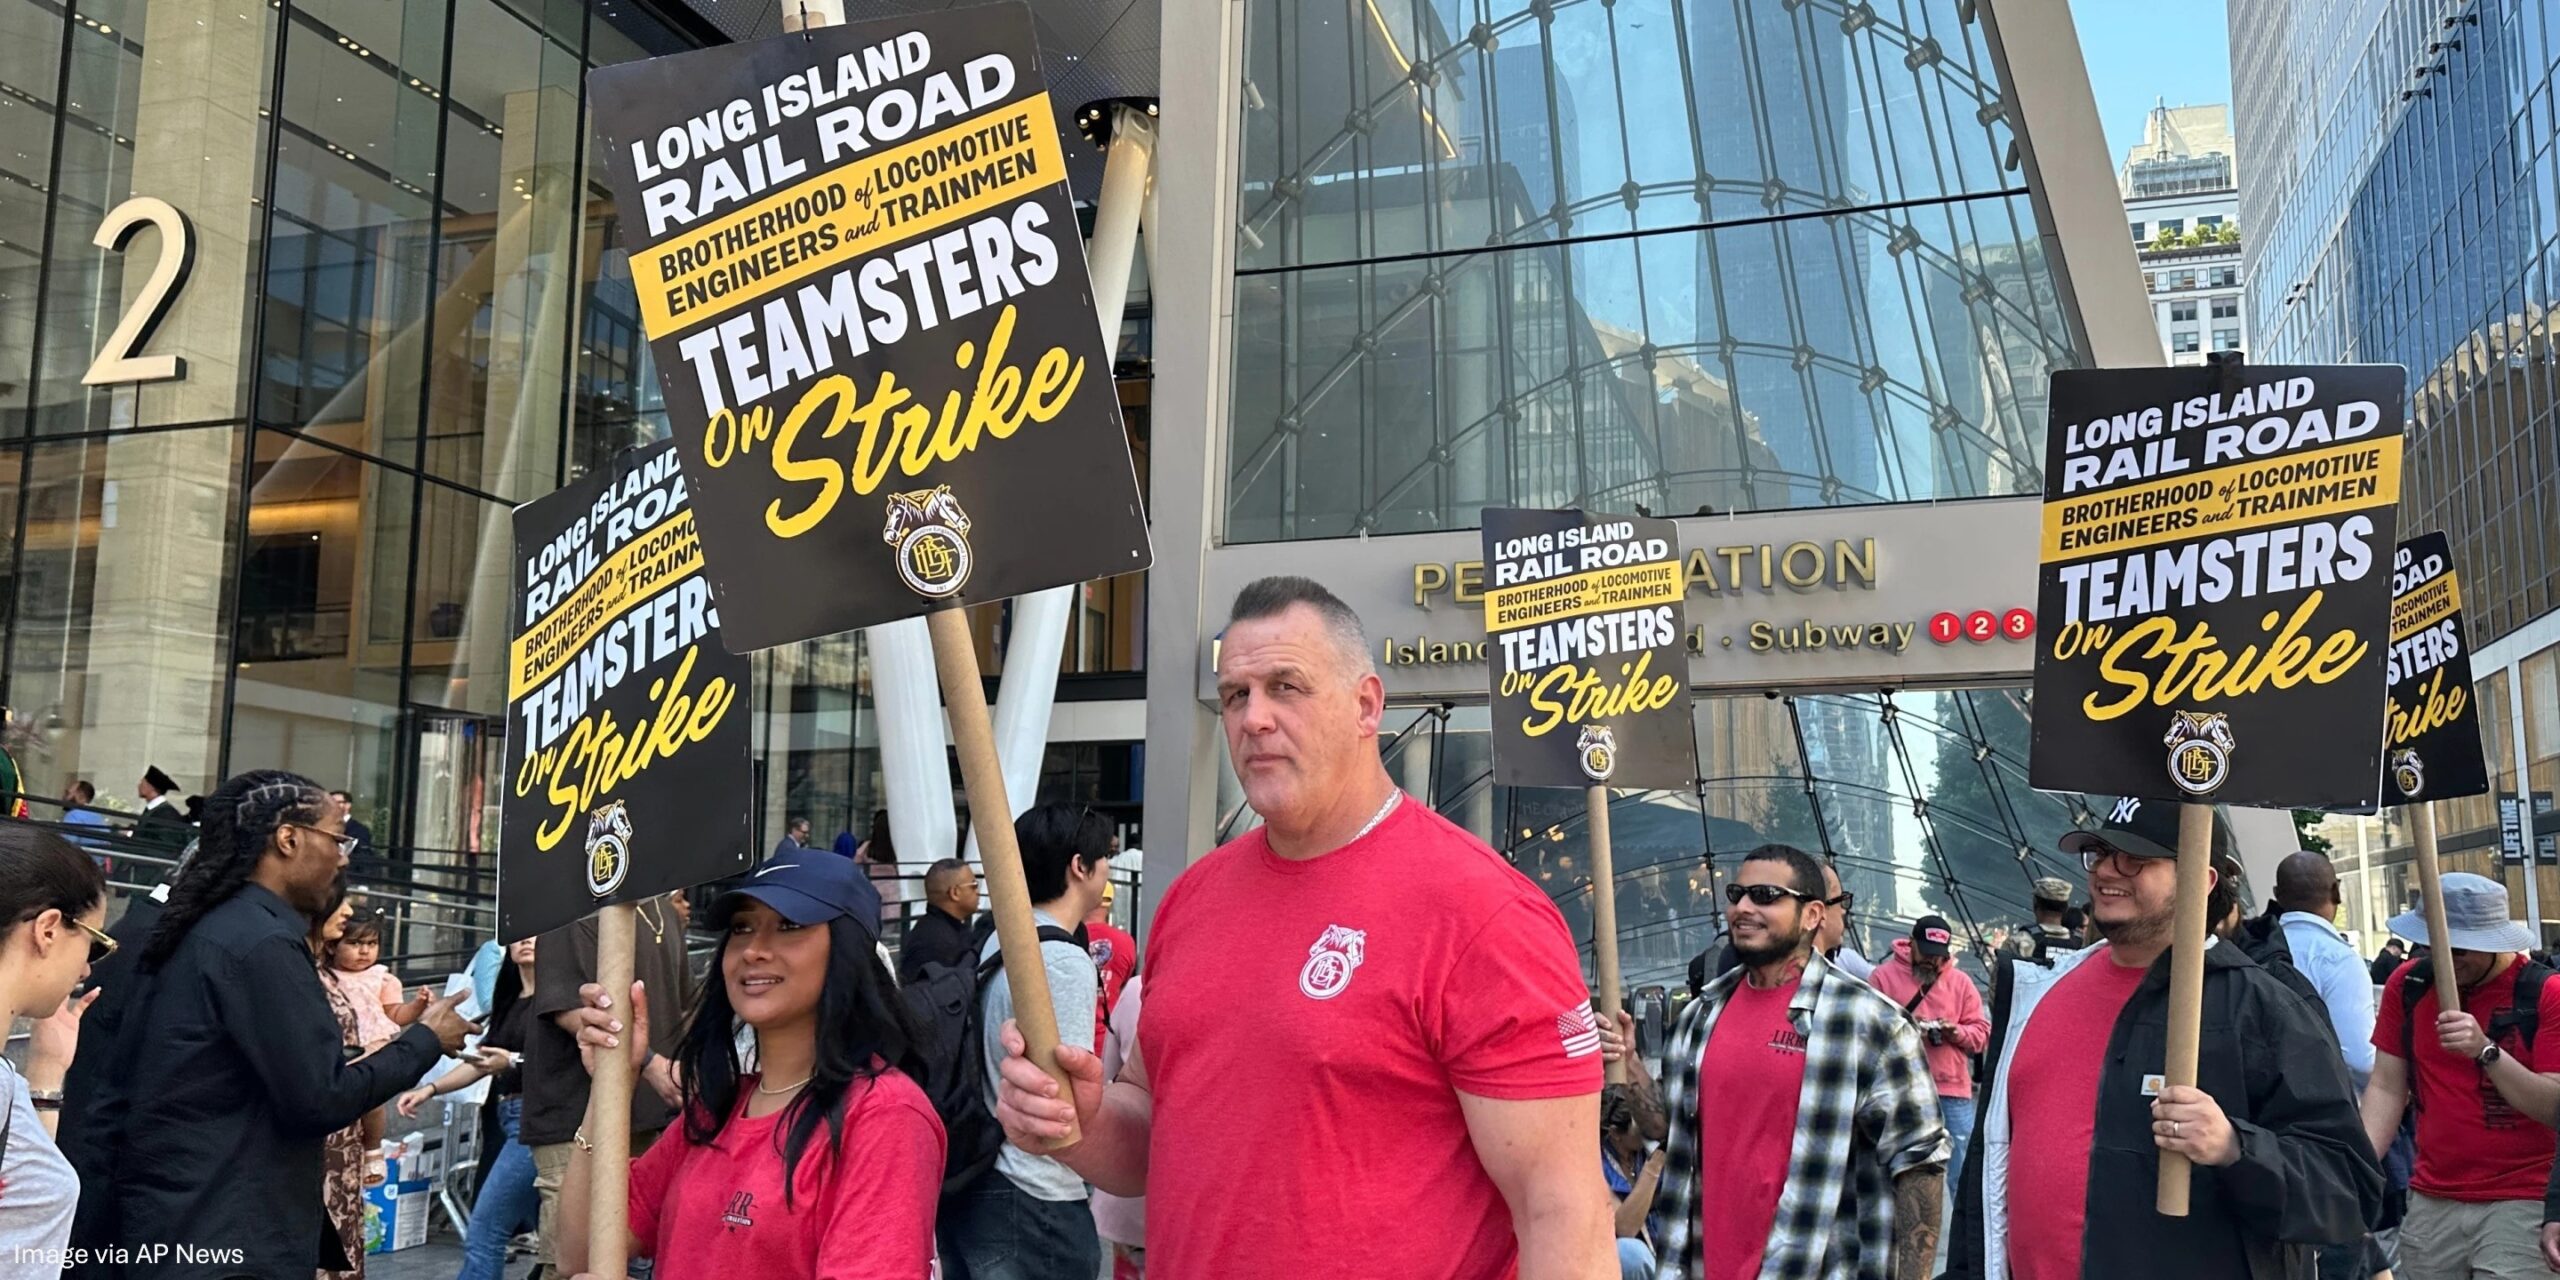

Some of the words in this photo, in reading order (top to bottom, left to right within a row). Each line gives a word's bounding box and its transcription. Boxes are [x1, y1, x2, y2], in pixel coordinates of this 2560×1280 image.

[630, 98, 758, 183] LONG
[762, 30, 932, 127] ISLAND
[641, 134, 805, 238] RAIL
[816, 53, 1016, 165] ROAD
[659, 182, 847, 283] BROTHERHOOD
[854, 175, 874, 209] of
[874, 113, 1032, 195] LOCOMOTIVE
[666, 222, 839, 316] ENGINEERS
[845, 214, 881, 243] and
[882, 148, 1039, 228] TRAINMEN
[81, 196, 194, 386] 2
[679, 201, 1060, 419] TEAMSTERS
[703, 401, 774, 469] On
[765, 304, 1085, 538] Strike
[2062, 437, 2190, 494] RAIL
[2204, 400, 2381, 465] ROAD
[2065, 407, 2163, 454] LONG
[2171, 376, 2315, 431] ISLAND
[2059, 508, 2198, 551] ENGINEERS
[2201, 506, 2236, 525] and
[2236, 475, 2377, 518] TRAINMEN
[2061, 479, 2213, 527] BROTHERHOOD
[2219, 478, 2237, 501] of
[2238, 449, 2381, 494] LOCOMOTIVE
[525, 538, 600, 628] RAIL
[606, 474, 689, 555] ROA
[527, 516, 587, 589] LONG
[1414, 561, 1485, 605] PE
[1682, 537, 1876, 591] ATION
[1494, 533, 1553, 561] LONG
[1558, 521, 1634, 548] ISLAND
[1495, 553, 1573, 587] RAIL
[1580, 539, 1669, 570] ROAD
[2059, 514, 2374, 626] TEAMSTERS
[525, 567, 613, 660] BROTHERHOOD
[616, 558, 628, 581] of
[629, 515, 696, 571] LOCOMO
[1497, 578, 1588, 608] BROTHERHOOD
[1591, 578, 1601, 593] of
[1601, 567, 1671, 589] LOCOMOTIVE
[1498, 596, 1582, 624] ENGINEERS
[1584, 595, 1602, 607] and
[1602, 582, 1672, 604] TRAINMEN
[2392, 580, 2448, 620] OCOMOTIVE
[2392, 595, 2450, 635] TRAINMEN
[523, 600, 604, 685] ENGINEERS
[605, 582, 628, 612] and
[1499, 605, 1675, 673] TEAMSTERS
[1750, 619, 1916, 653] Subway
[2053, 619, 2113, 660] On
[2082, 589, 2369, 721] Strike
[2388, 618, 2459, 687] STERS
[1500, 669, 1537, 697] On
[1522, 650, 1679, 737] Strike
[2384, 666, 2467, 750] trike
[516, 747, 557, 798] On
[536, 644, 736, 851] Strike
[2500, 799, 2521, 859] LIFETIME
